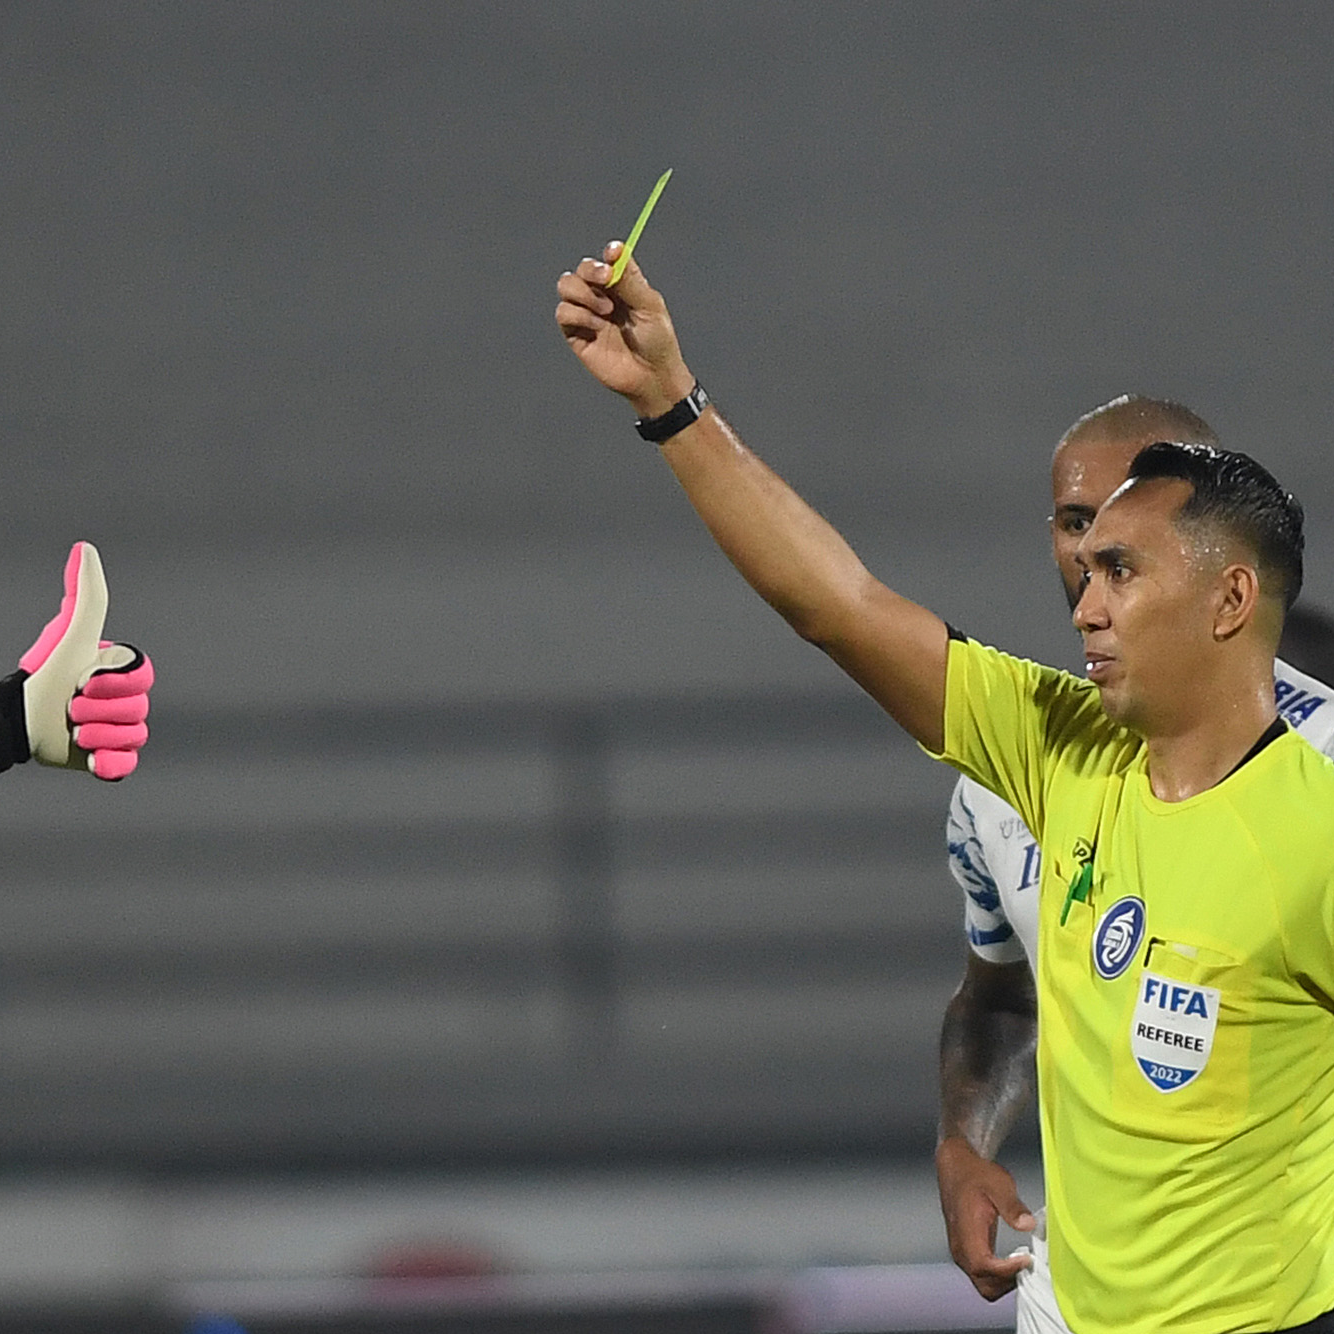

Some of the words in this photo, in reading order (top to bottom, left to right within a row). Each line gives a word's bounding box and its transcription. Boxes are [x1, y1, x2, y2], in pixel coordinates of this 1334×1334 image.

[1274, 680, 1327, 721] RIA
[1143, 977, 1209, 1020] FIFA
[1136, 1022, 1205, 1054] REFEREE
[1149, 1064, 1183, 1085] 2022
